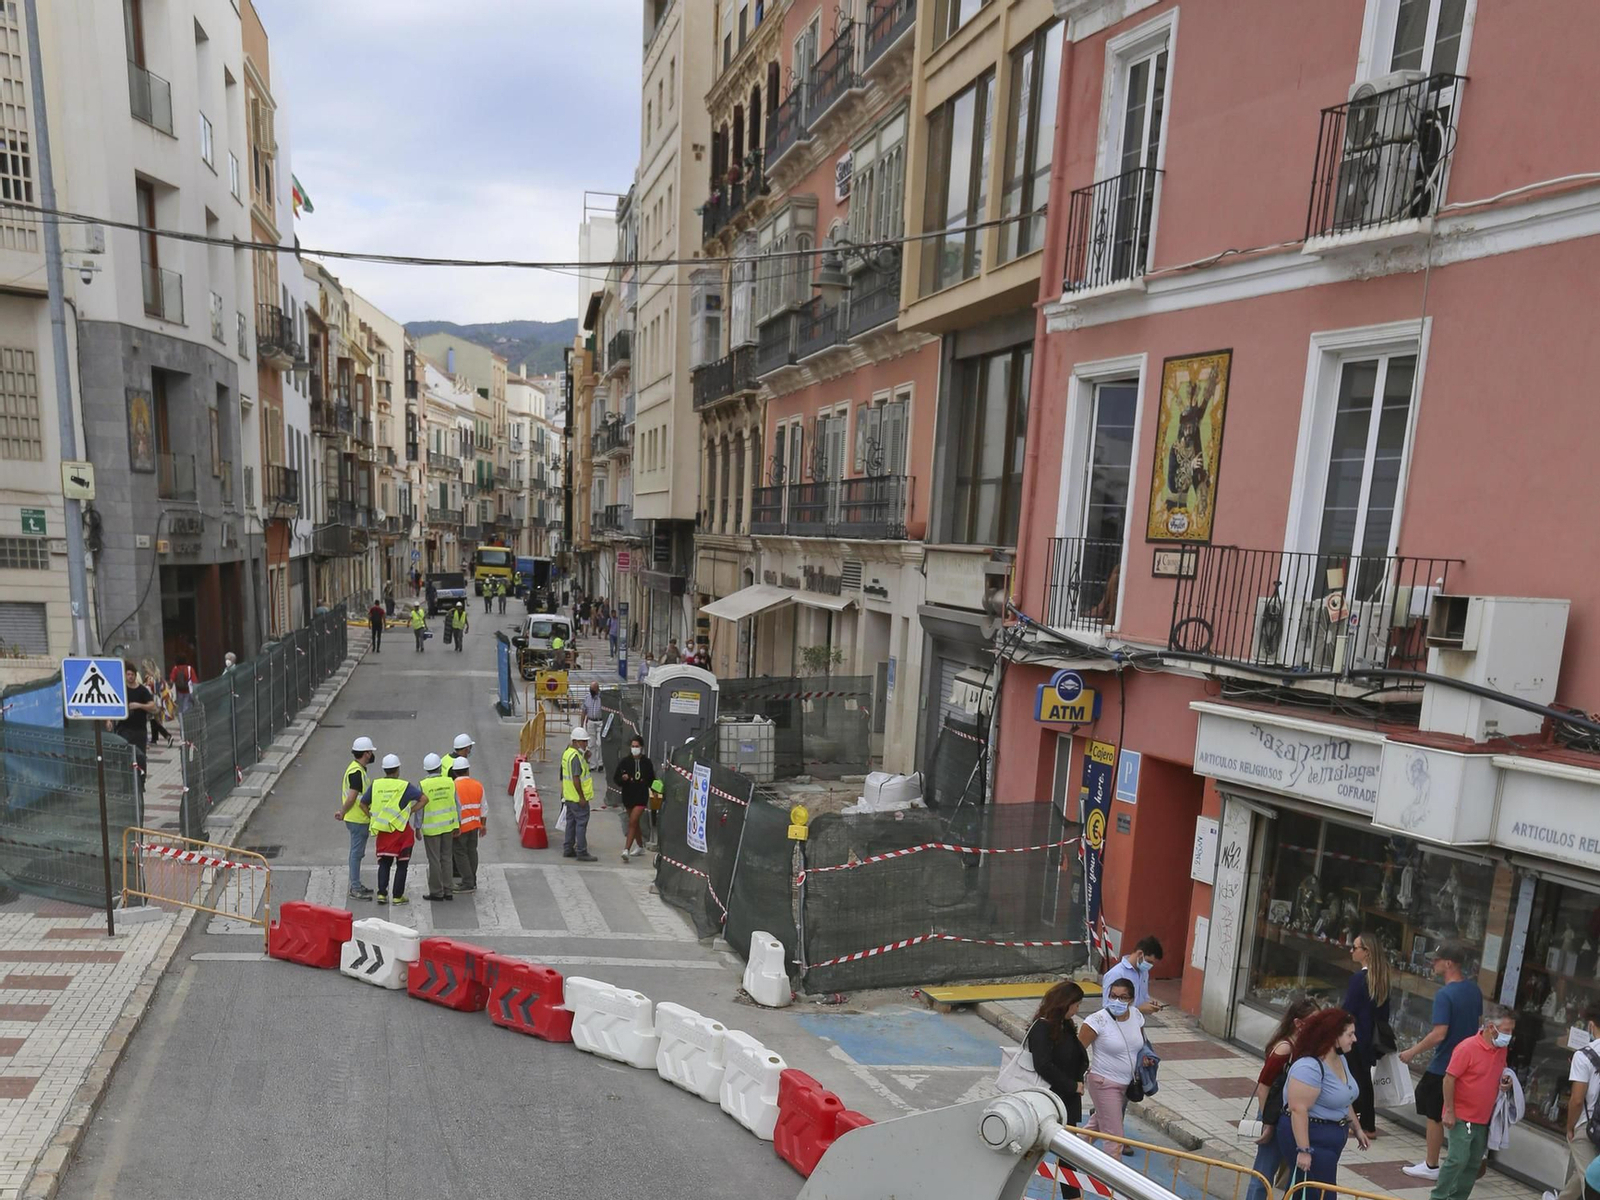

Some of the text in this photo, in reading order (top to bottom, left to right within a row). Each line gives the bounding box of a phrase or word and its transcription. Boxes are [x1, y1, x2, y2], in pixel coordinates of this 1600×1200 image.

[1048, 704, 1085, 721] ATM
[1092, 745, 1114, 762] Cajero
[1198, 751, 1283, 782] ARTICULOS RELIGIOSOS
[1337, 783, 1377, 803] COFRADE
[1511, 821, 1576, 849] ARTICULOS
[1088, 852, 1097, 883] your
